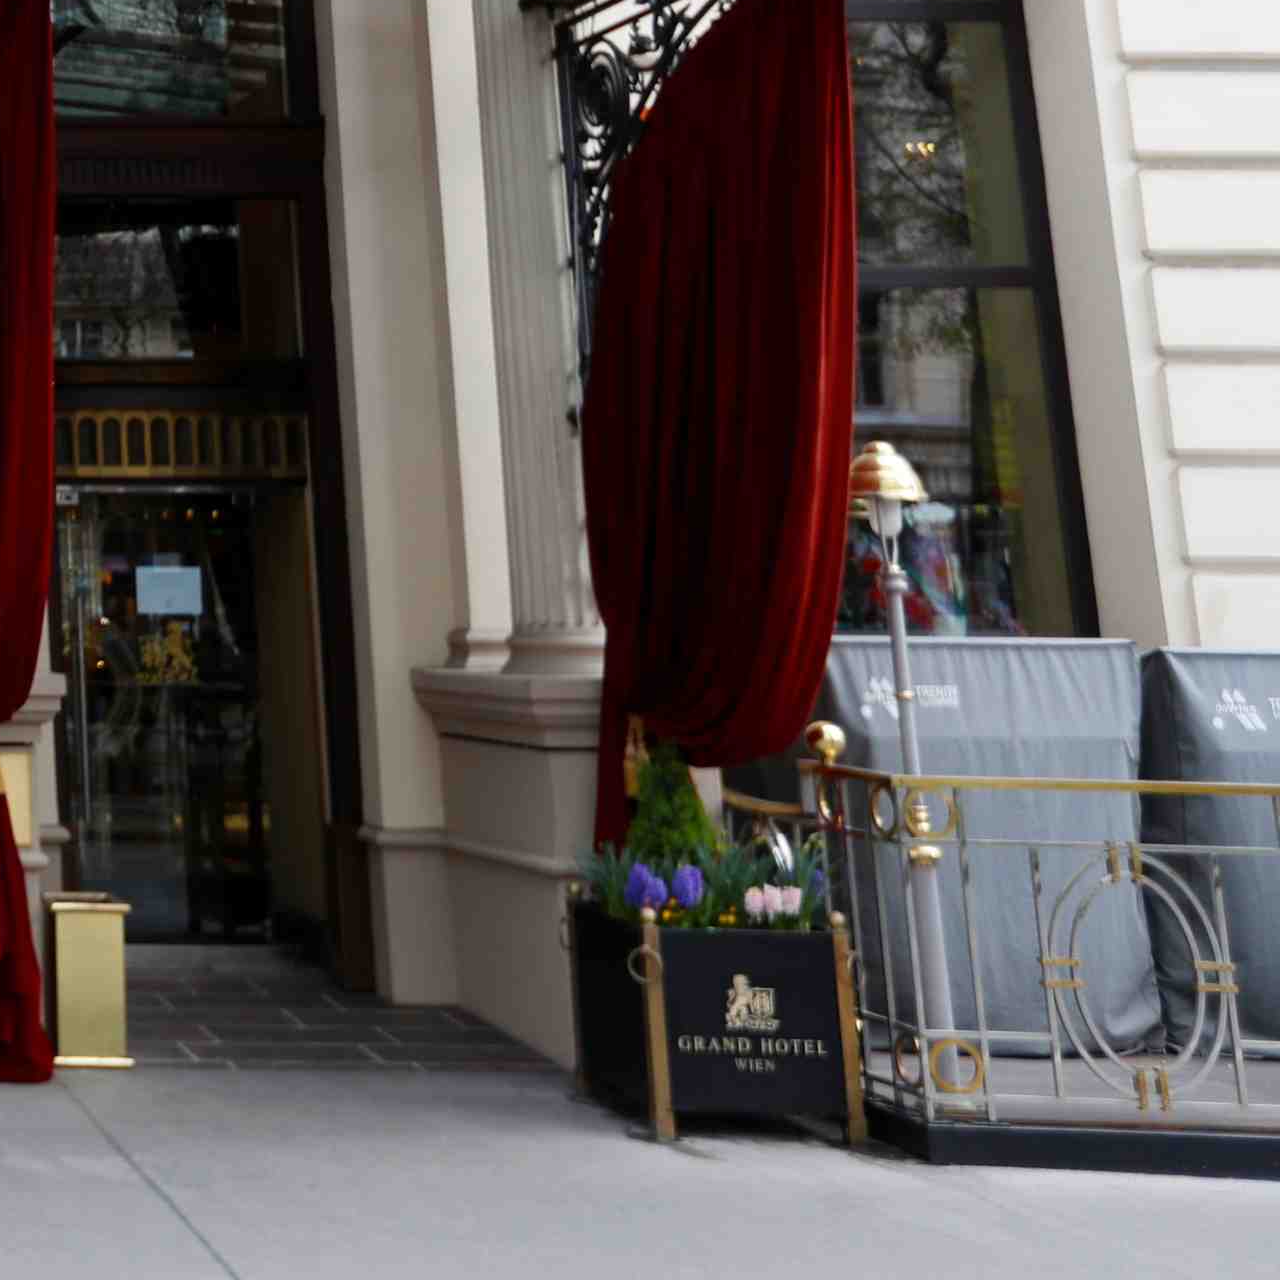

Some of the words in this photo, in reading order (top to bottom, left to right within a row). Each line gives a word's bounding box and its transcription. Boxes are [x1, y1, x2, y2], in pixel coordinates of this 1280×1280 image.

[677, 1034, 752, 1055] GRAND
[760, 1037, 828, 1057] HOTEL
[734, 1056, 776, 1073] WIEN
